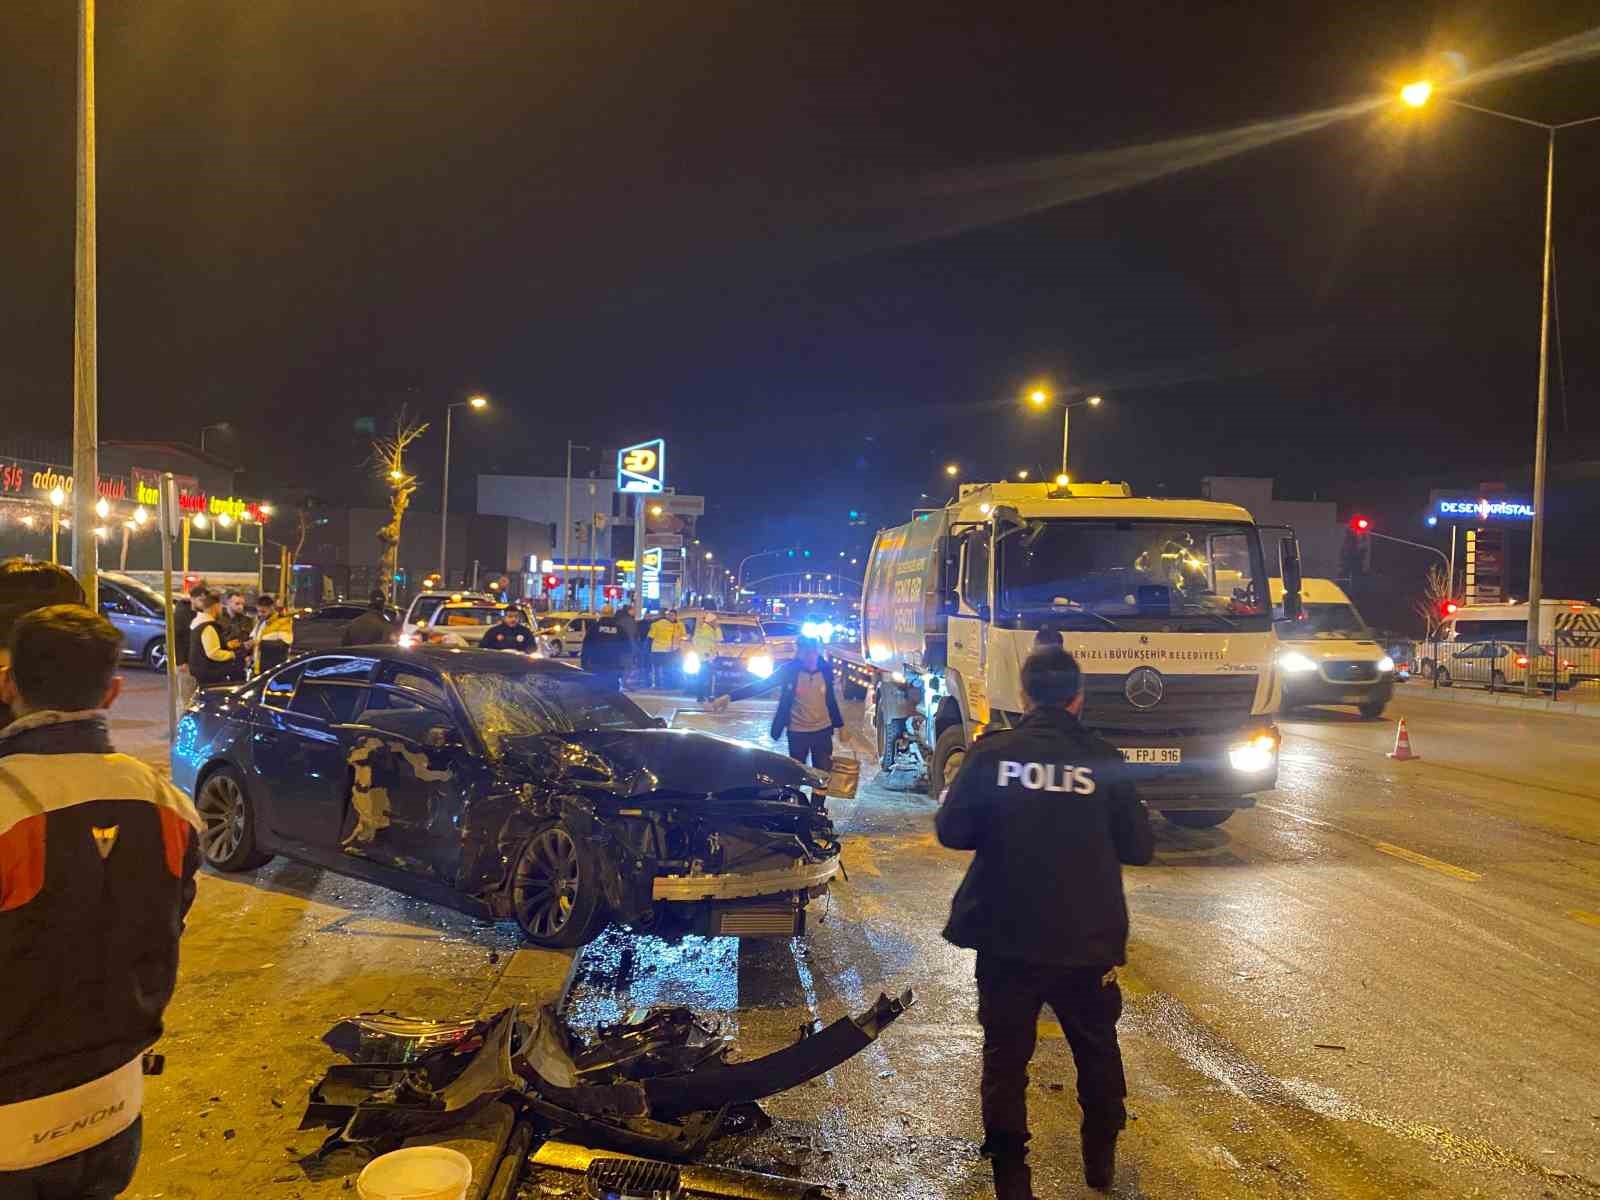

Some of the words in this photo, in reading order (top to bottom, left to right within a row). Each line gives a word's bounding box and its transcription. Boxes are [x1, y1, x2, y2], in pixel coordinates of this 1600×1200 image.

[1440, 502, 1481, 513] DESEN
[1136, 750, 1156, 761] FPJ
[1161, 750, 1178, 761] 916
[32, 1101, 125, 1144] VENOM
